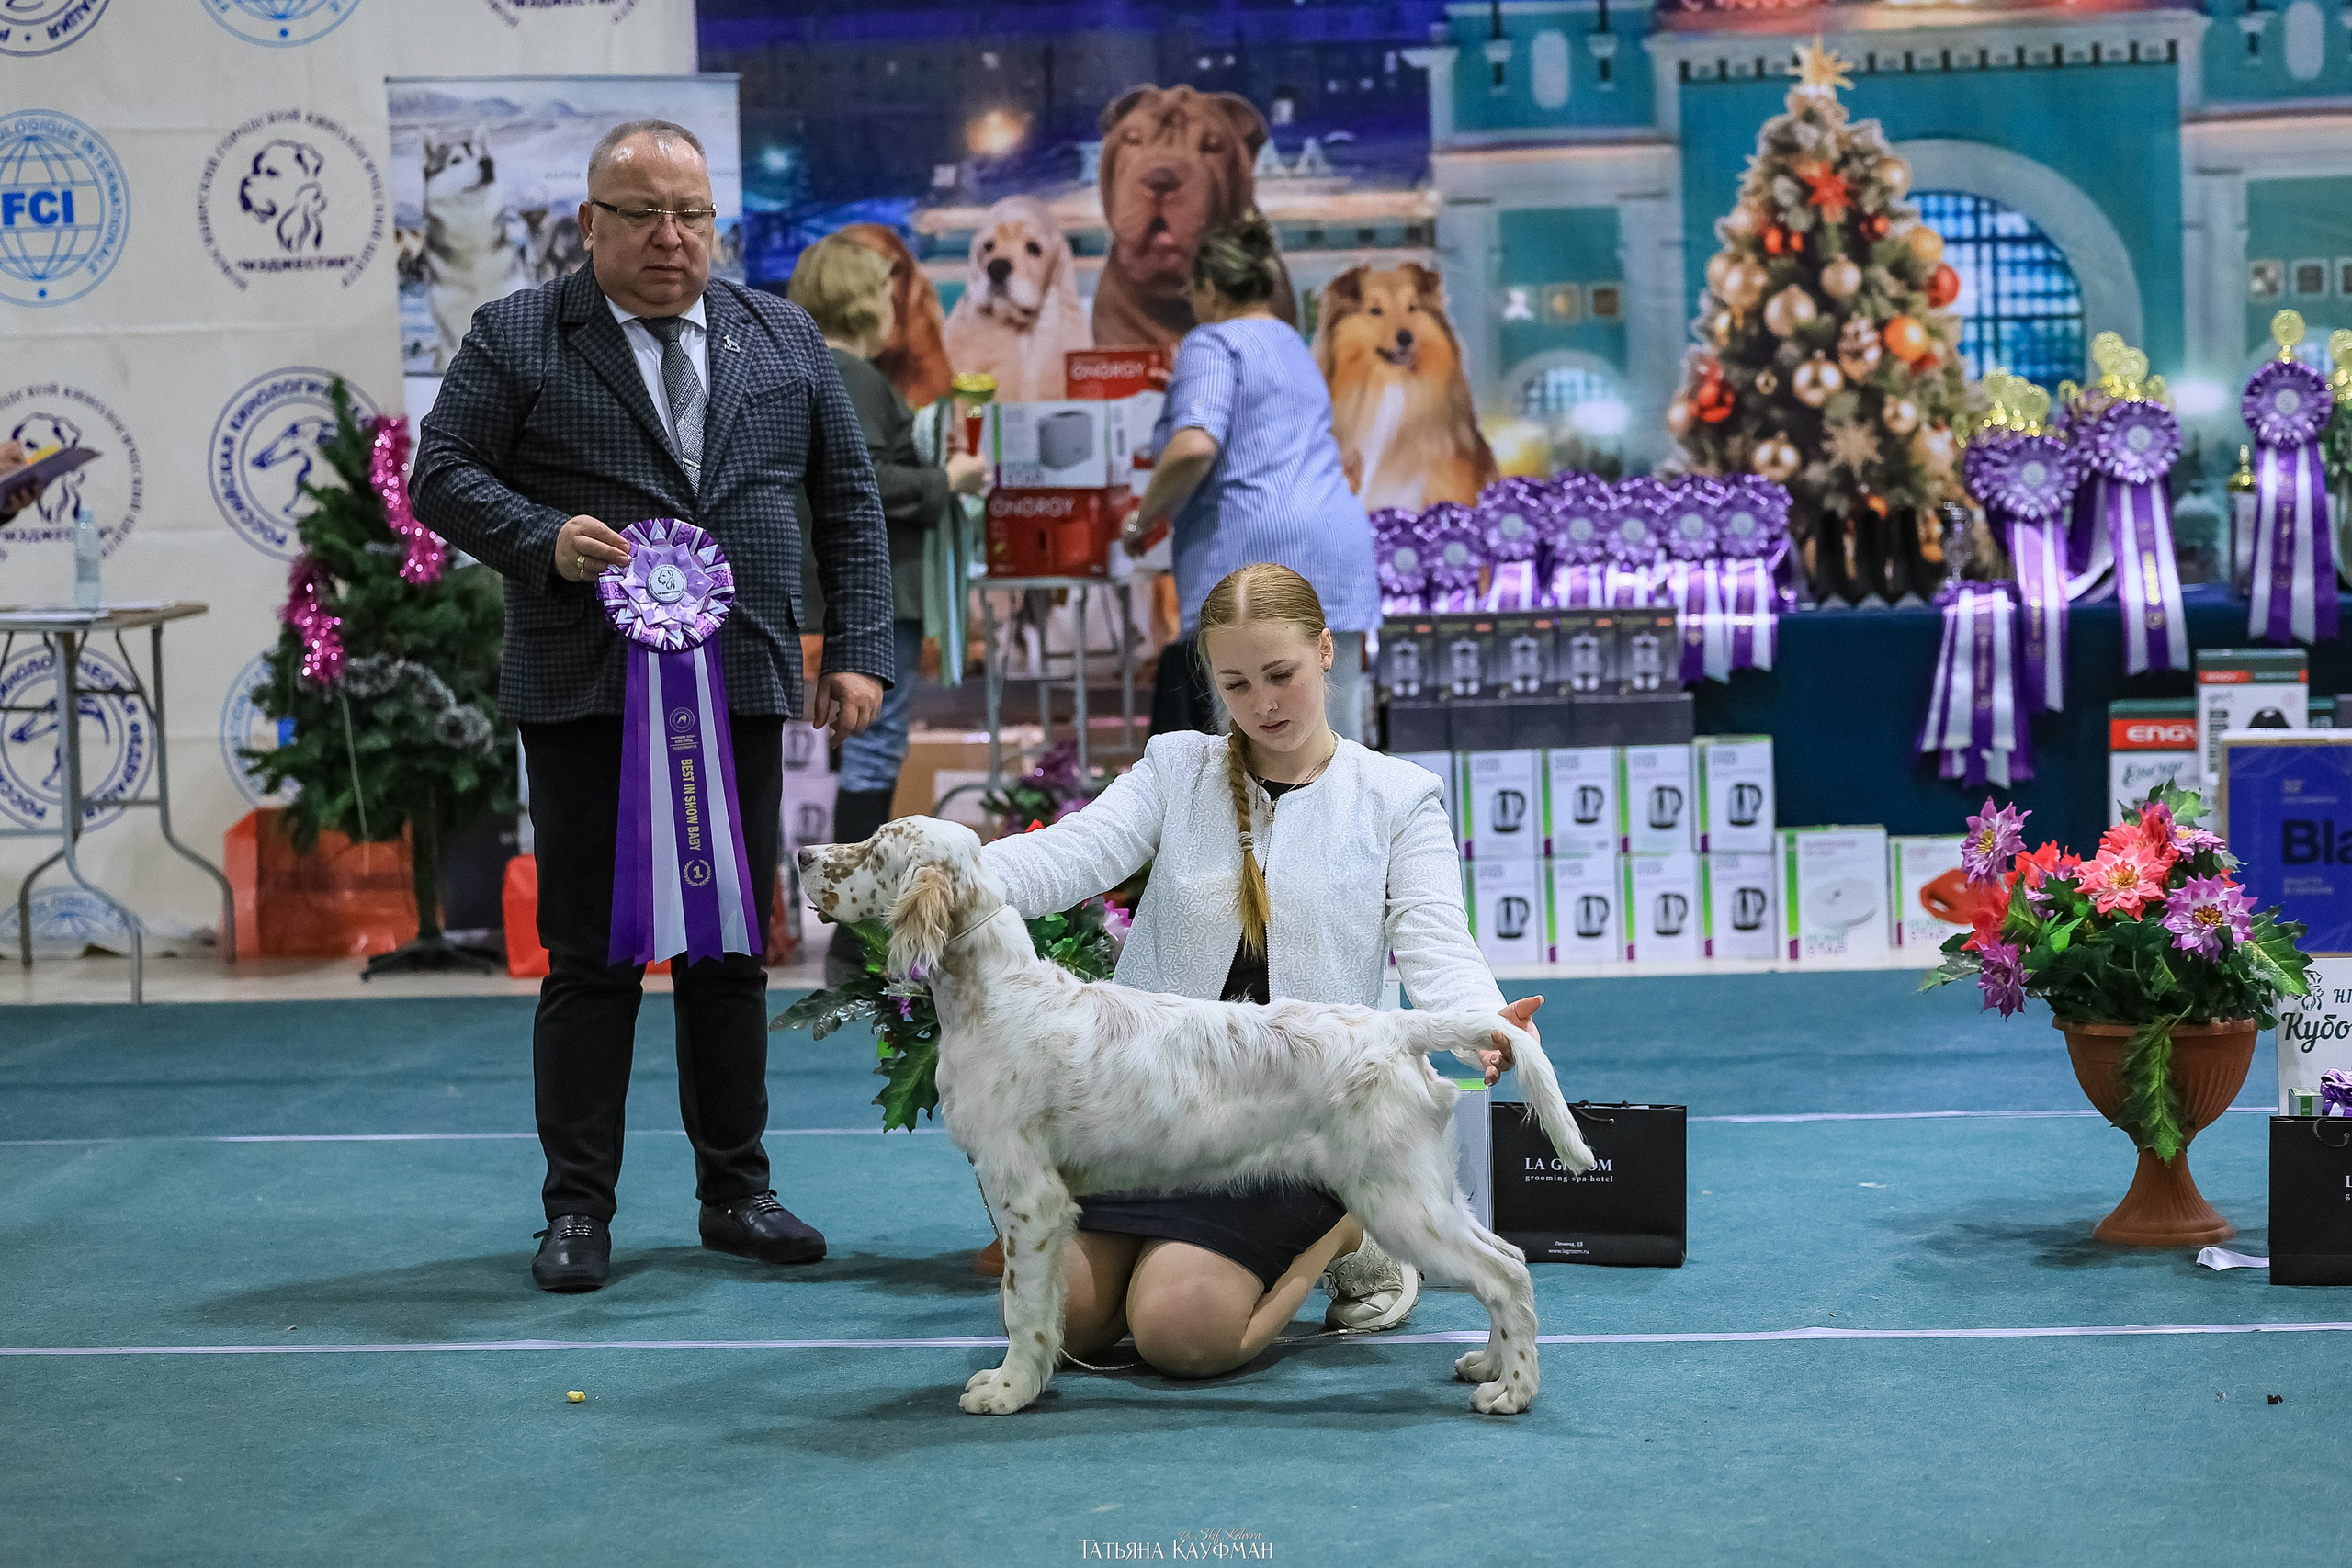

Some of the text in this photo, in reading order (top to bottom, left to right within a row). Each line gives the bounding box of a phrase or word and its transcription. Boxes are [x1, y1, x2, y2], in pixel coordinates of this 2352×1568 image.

[1, 190, 75, 227] FCI
[681, 759, 695, 782] BEST
[684, 784, 695, 794] IN
[684, 795, 698, 824] SHOW
[687, 827, 701, 851] BABY
[693, 865, 704, 879] 1
[1525, 1157, 1612, 1172] LA GOM
